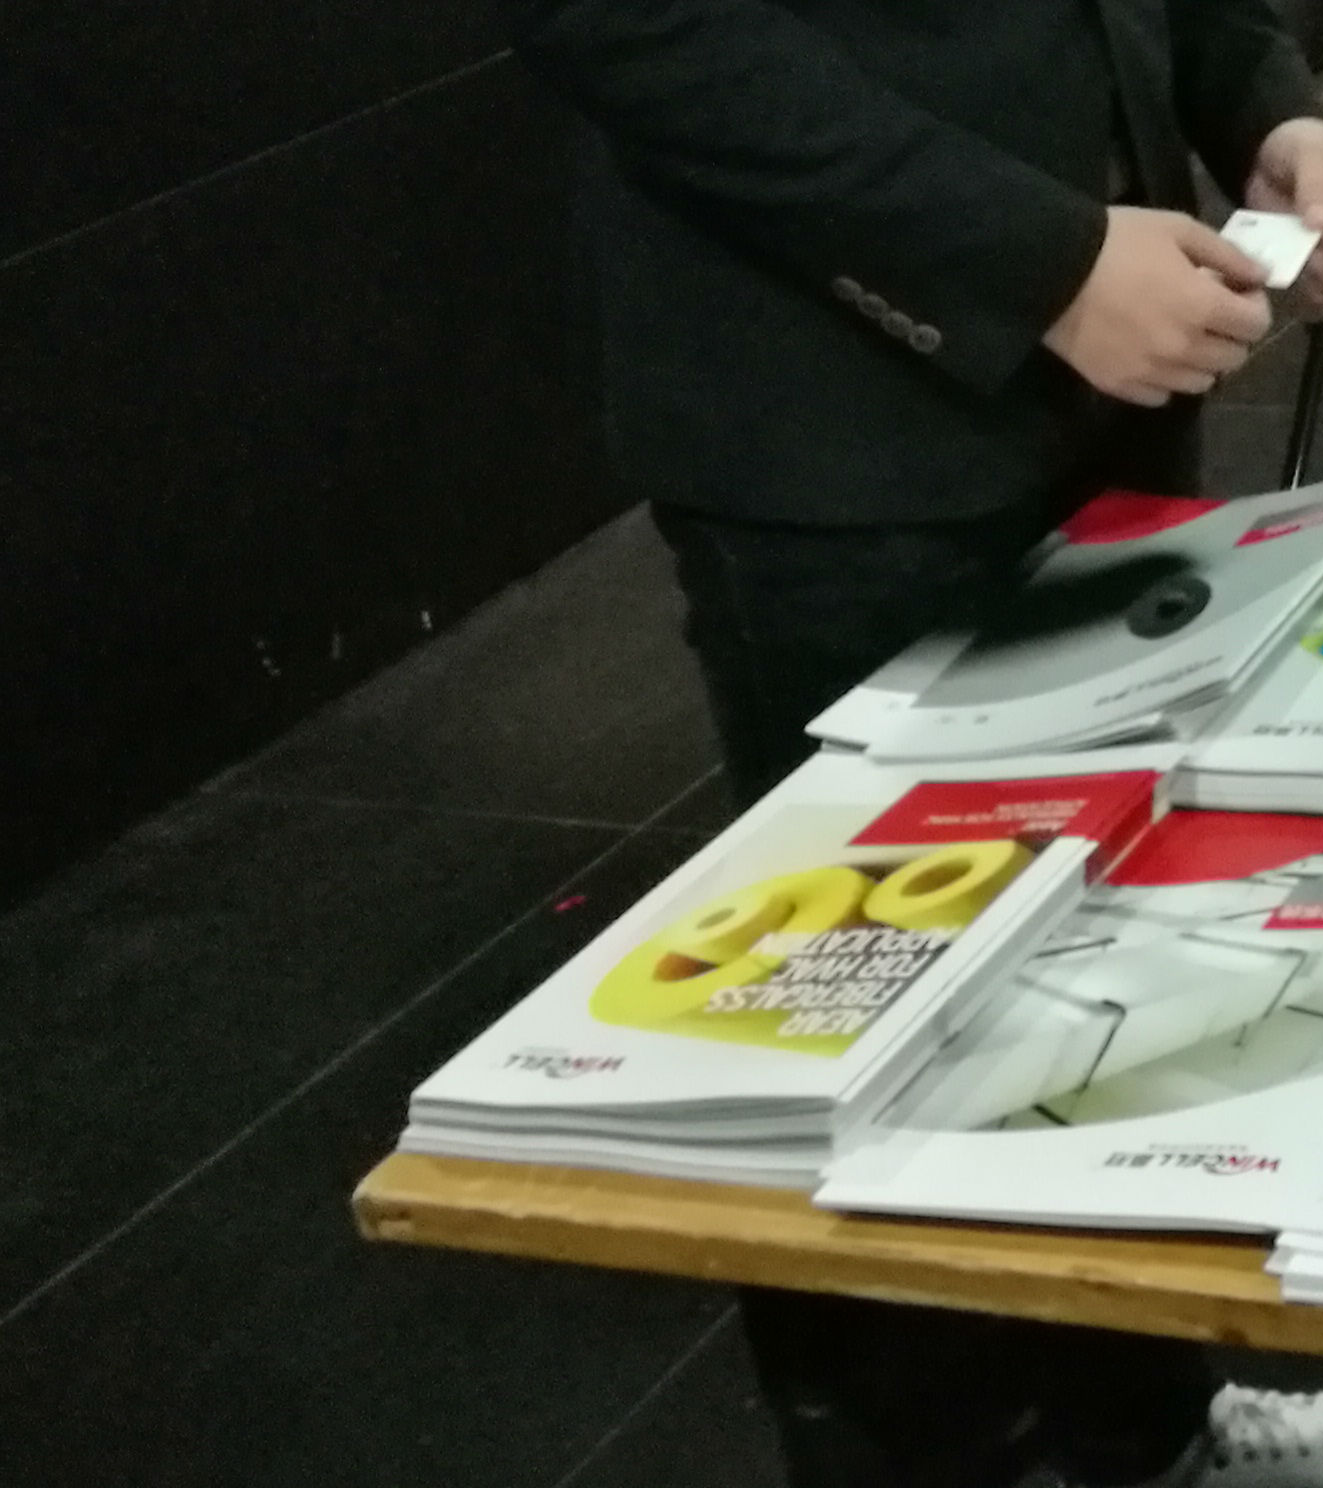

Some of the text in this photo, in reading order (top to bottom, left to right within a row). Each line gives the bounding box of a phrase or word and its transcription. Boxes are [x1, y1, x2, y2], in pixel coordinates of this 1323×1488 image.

[769, 953, 931, 984] FOR HVAC
[1159, 1154, 1281, 1176] WINCELL
